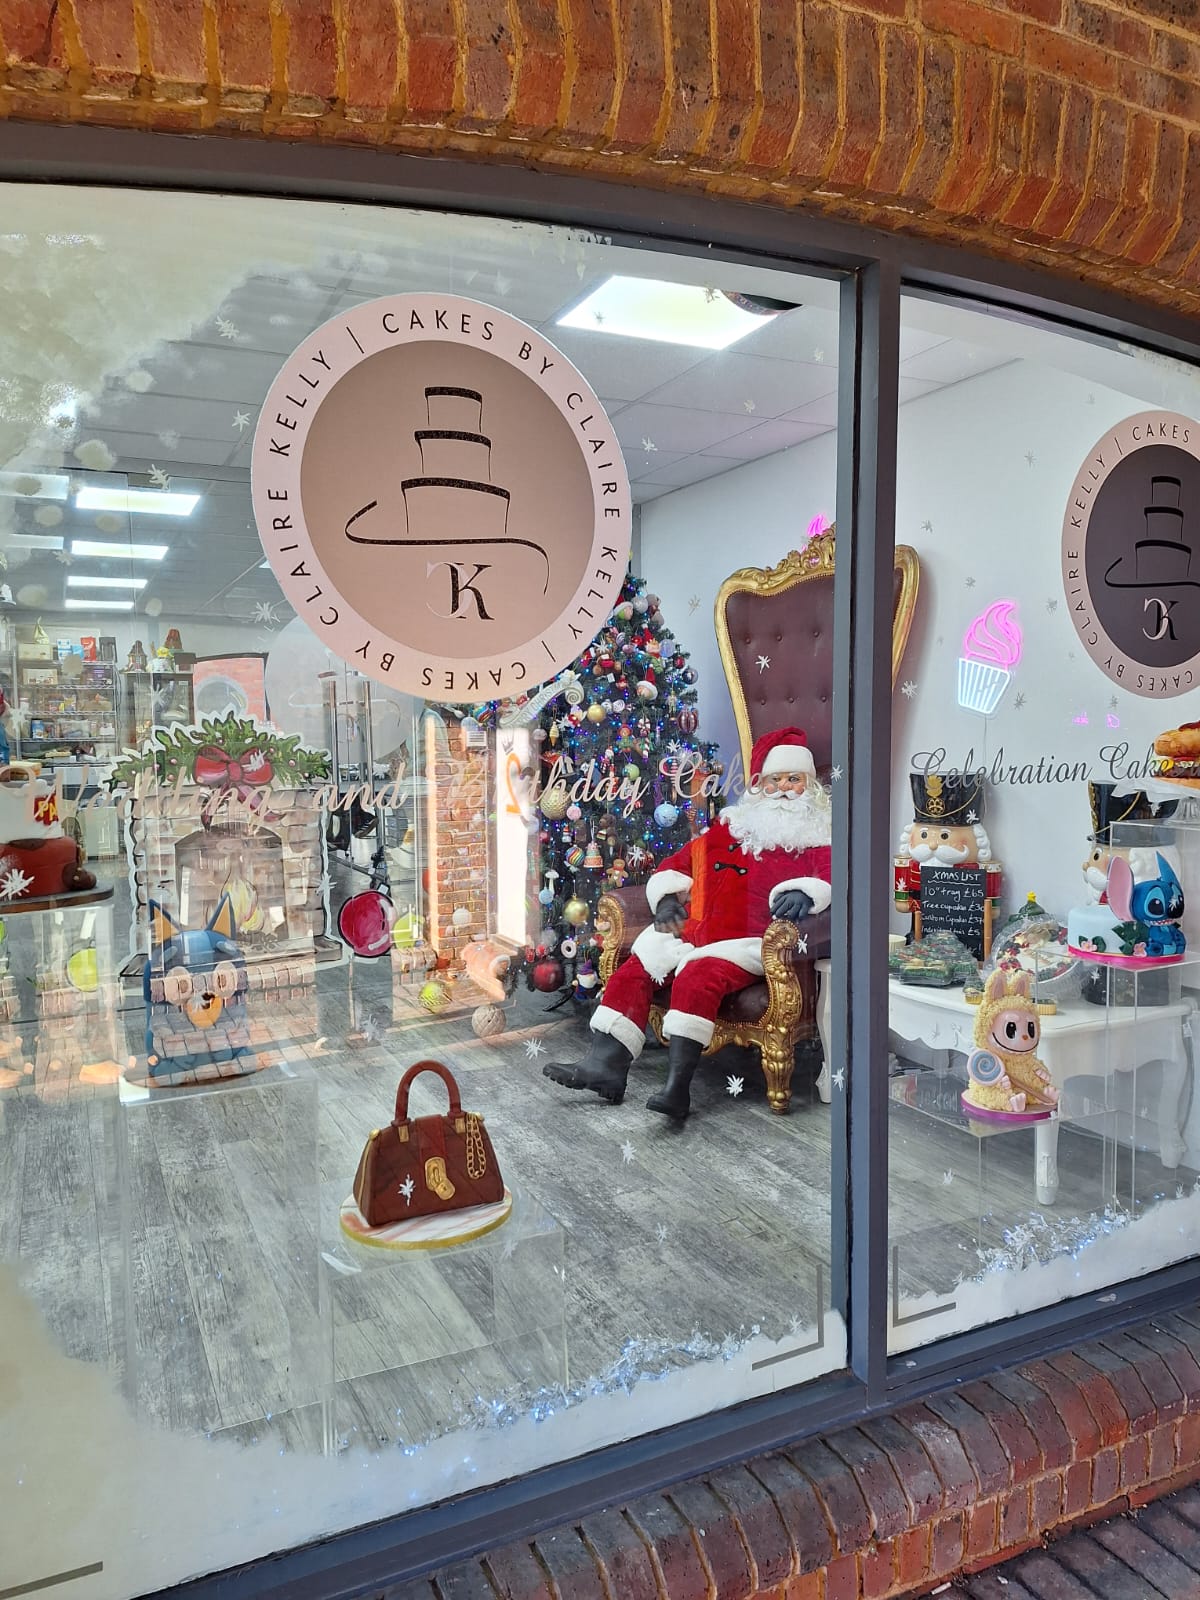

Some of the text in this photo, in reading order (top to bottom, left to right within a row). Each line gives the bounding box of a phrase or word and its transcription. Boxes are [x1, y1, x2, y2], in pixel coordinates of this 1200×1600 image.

[1132, 422, 1190, 443] CAKES
[382, 309, 621, 640] CAKES BY CLAIRE KELLY
[267, 350, 526, 690] CAKES BY CLAIRE KELLY
[1067, 453, 1193, 692] CAKES BY CLAIRE KELLY
[312, 761, 408, 812] and
[910, 746, 1093, 790] Celebration
[932, 871, 981, 881] XMAS LIST
